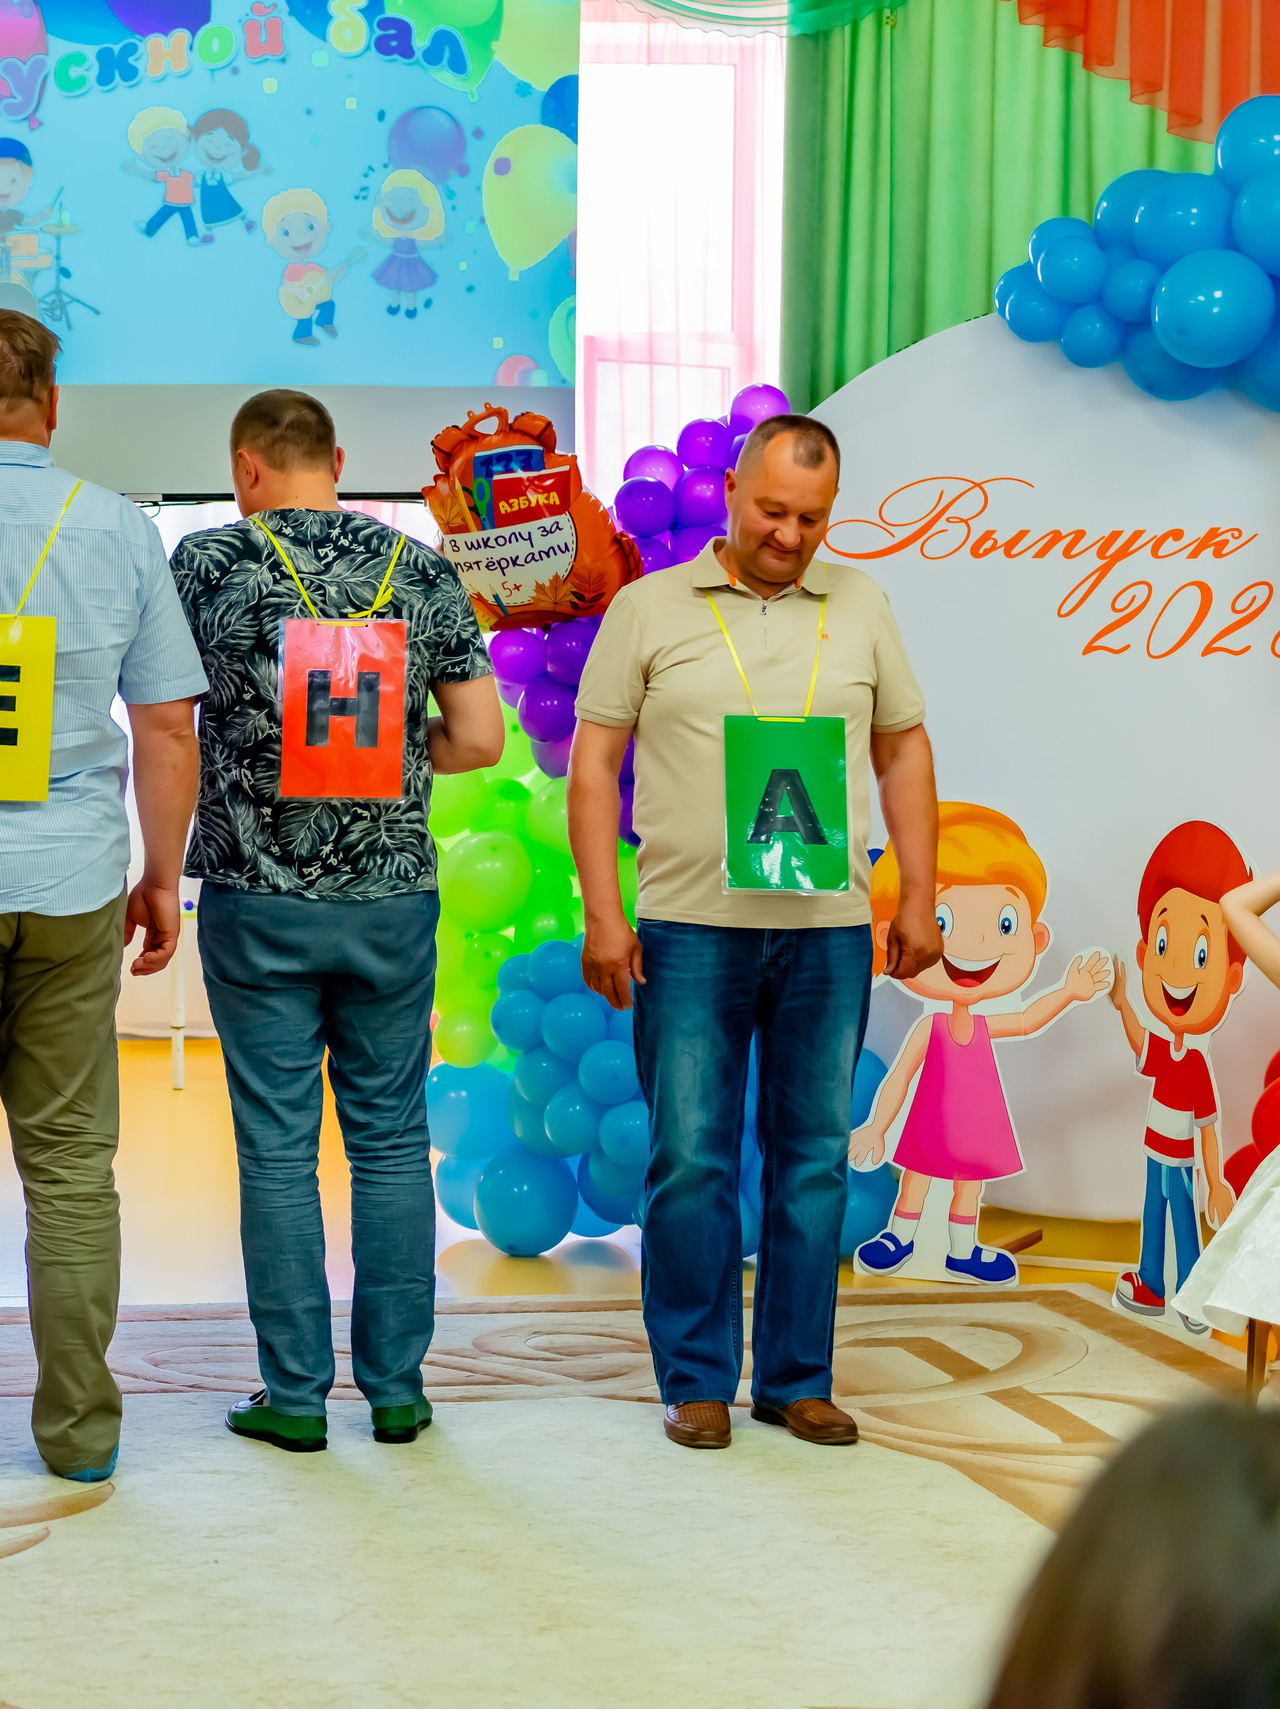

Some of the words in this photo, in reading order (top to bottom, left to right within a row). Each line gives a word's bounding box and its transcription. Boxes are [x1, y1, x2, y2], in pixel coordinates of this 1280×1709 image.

[329, 0, 471, 79] бал
[464, 531, 535, 552] школу
[537, 520, 564, 538] за
[498, 491, 560, 515] АЗБУКА
[454, 541, 571, 577] пятёрками
[823, 476, 1259, 619] Выпуск
[501, 580, 523, 599] 5+
[1082, 580, 1280, 660] 202
[305, 669, 381, 749] Н
[746, 768, 828, 846] А
